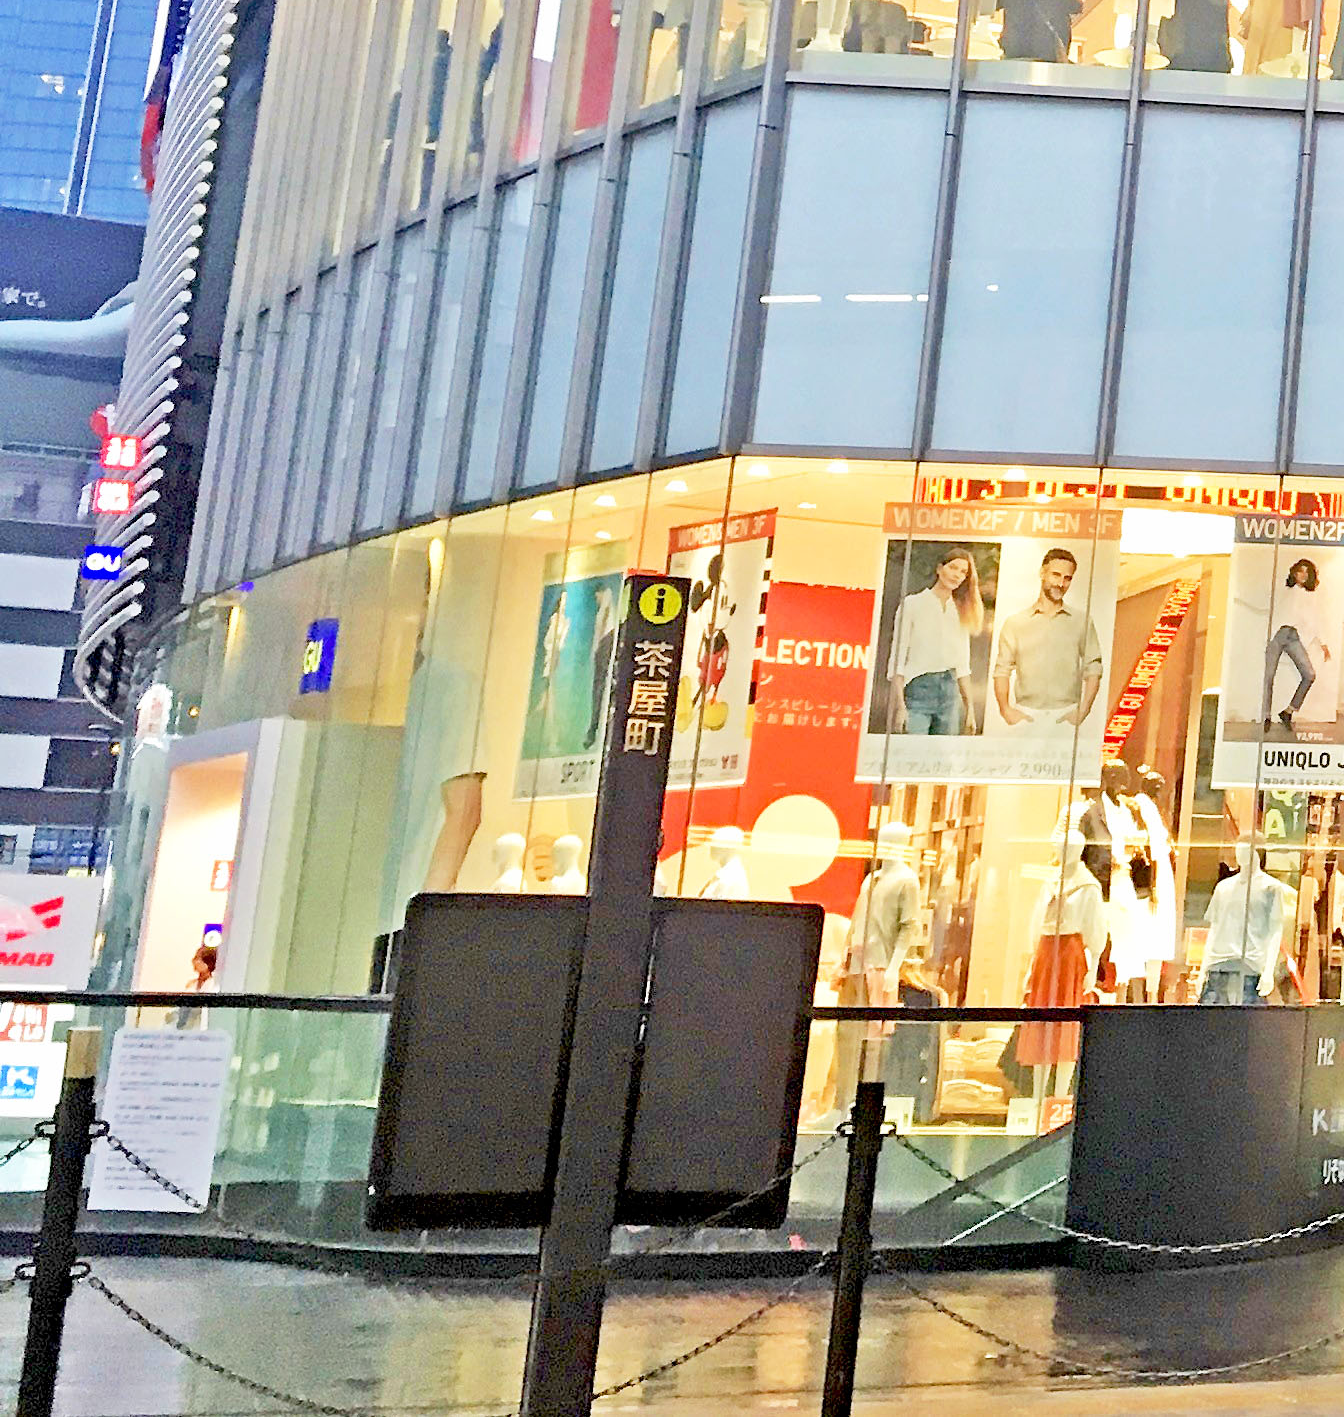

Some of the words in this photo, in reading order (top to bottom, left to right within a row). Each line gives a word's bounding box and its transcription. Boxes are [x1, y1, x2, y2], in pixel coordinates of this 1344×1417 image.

[894, 508, 1004, 532] WOMEN2F
[1032, 511, 1080, 534] MEN
[623, 639, 674, 756] 茶屋町
[1264, 750, 1331, 770] UNIQLO
